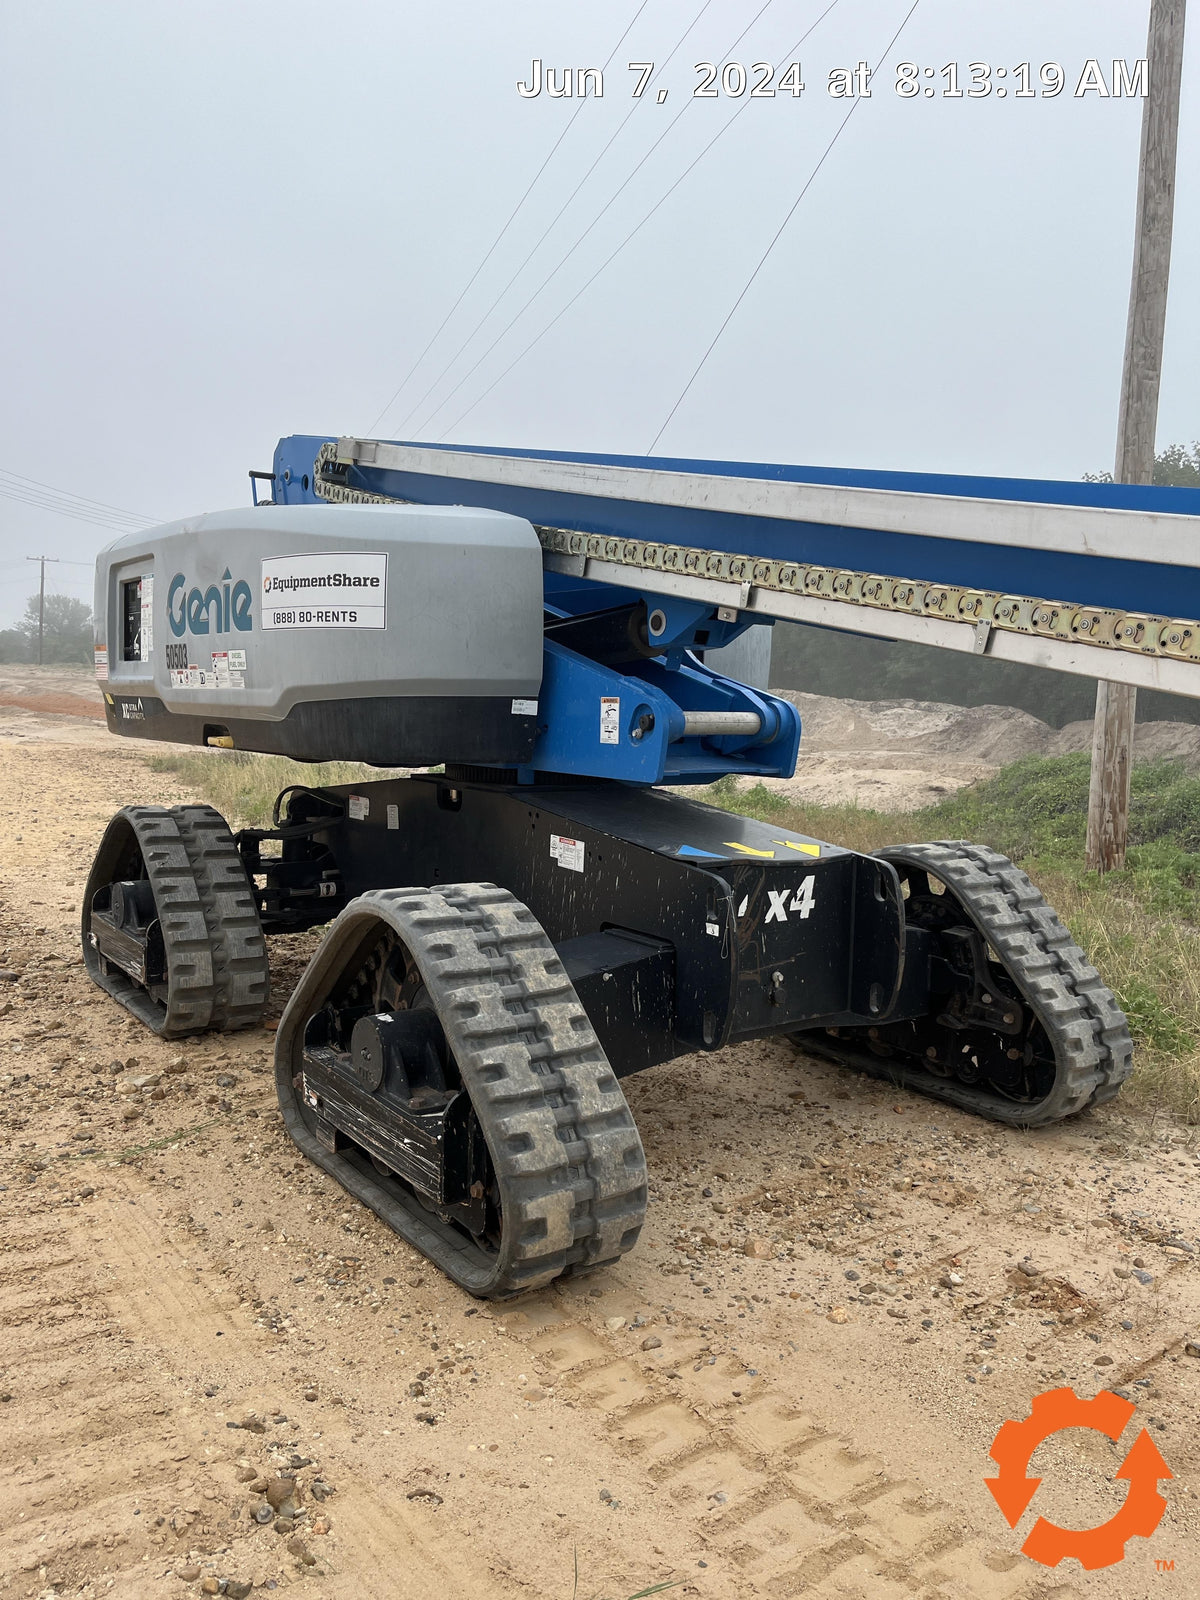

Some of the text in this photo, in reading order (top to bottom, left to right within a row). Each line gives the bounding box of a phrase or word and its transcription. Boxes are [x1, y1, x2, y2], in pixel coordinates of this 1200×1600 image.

[272, 573, 381, 593] EquipmentShare
[167, 566, 253, 638] Genie
[273, 610, 358, 625] (888) 80-RENTS
[165, 643, 188, 670] 50503
